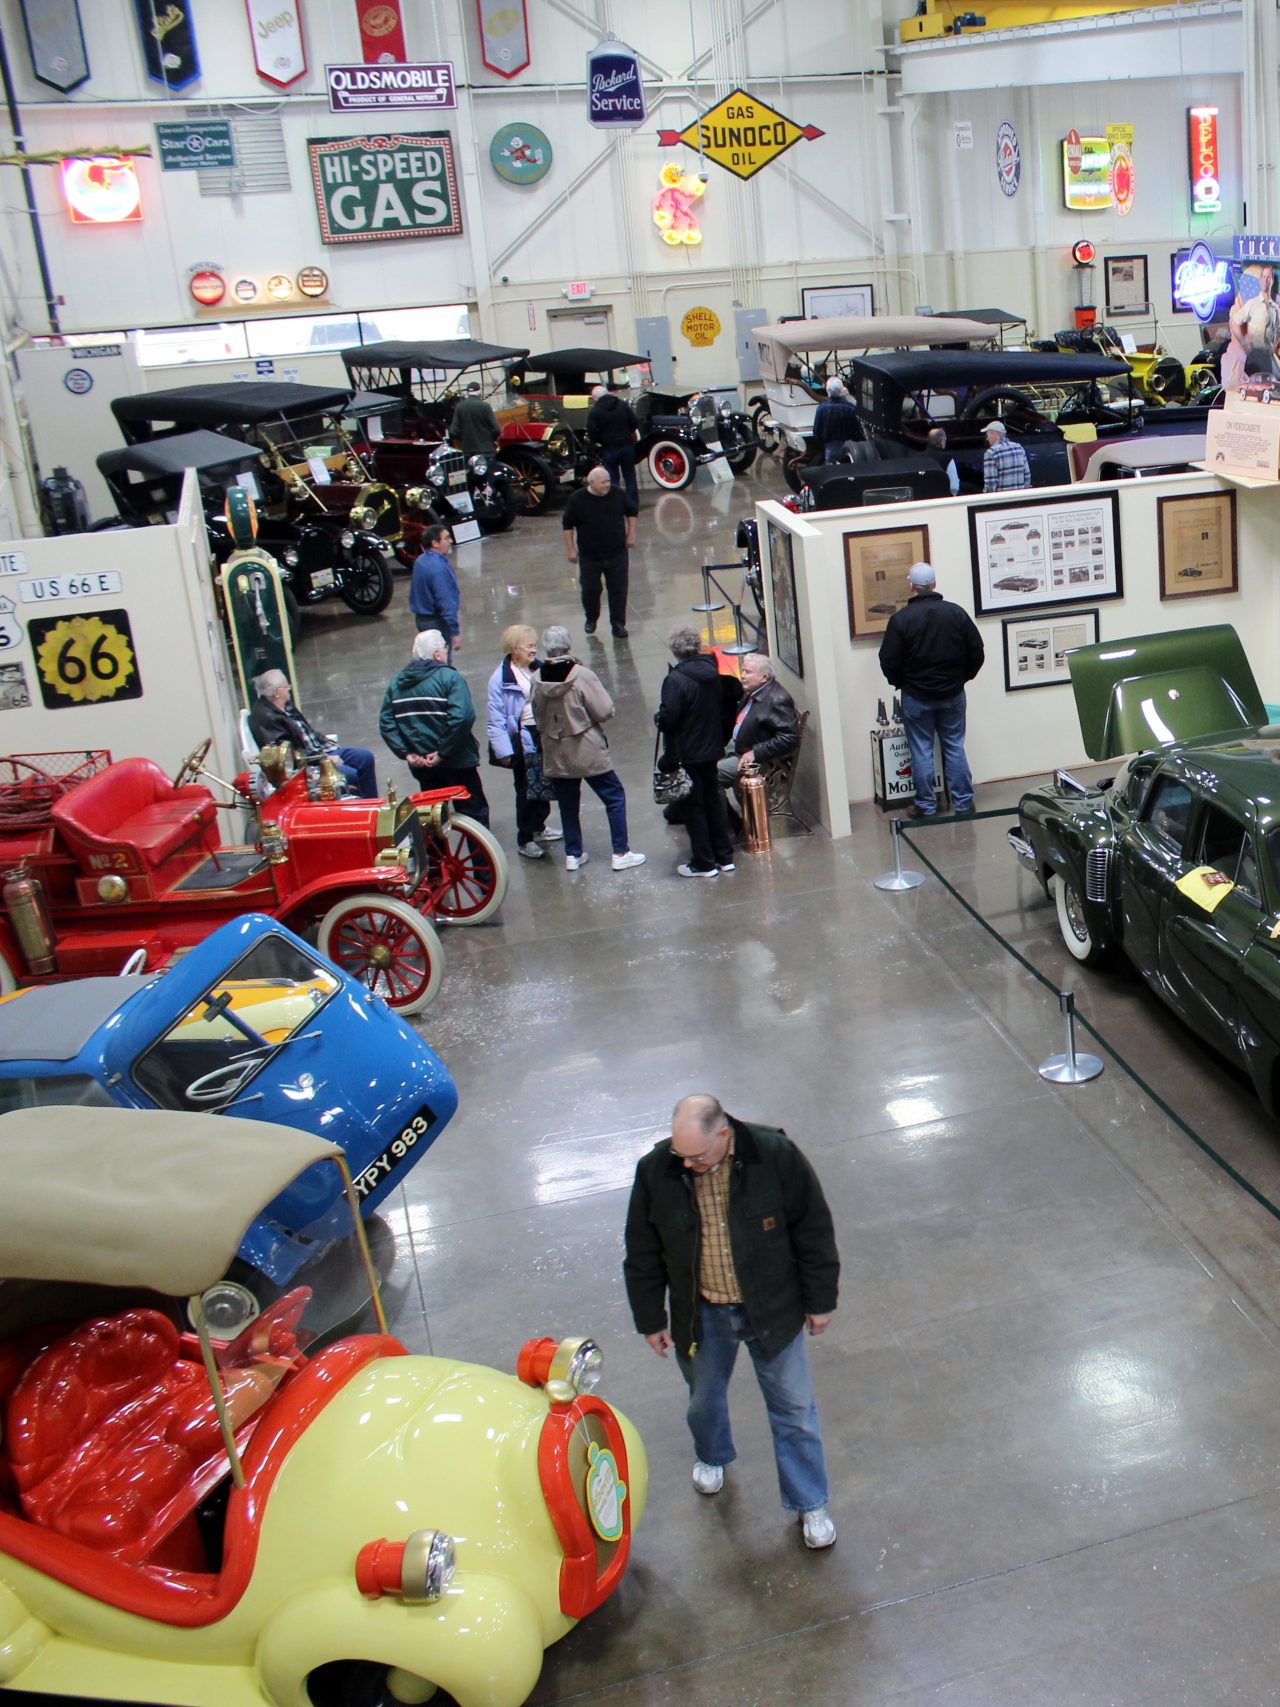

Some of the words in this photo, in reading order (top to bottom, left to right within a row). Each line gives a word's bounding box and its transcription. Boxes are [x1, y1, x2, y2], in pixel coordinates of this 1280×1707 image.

[257, 9, 294, 39] Jeep
[330, 69, 450, 90] OLDSMOBILE
[592, 64, 637, 92] Packard
[348, 95, 377, 103] PRODUCT
[378, 95, 387, 103] OF
[388, 94, 415, 103] GENERAL
[415, 93, 438, 102] MOTORS
[592, 92, 641, 111] Service
[726, 106, 755, 119] GAS
[160, 138, 187, 149] Star
[204, 137, 230, 148] Cars
[697, 121, 787, 149] SUNOCO
[1198, 114, 1215, 177] DELCO
[323, 151, 442, 183] HI-SPEED
[731, 152, 756, 166] OIL
[330, 180, 448, 230] GAS
[571, 283, 586, 295] EXIT
[685, 312, 714, 323] SHELL
[686, 322, 716, 333] MOTOR
[694, 331, 709, 341] OIL
[69, 577, 92, 596] 66
[100, 575, 111, 592] E
[56, 633, 120, 686] 66
[112, 853, 129, 869] 2
[354, 1153, 392, 1196] YPY
[391, 1116, 428, 1158] 983
